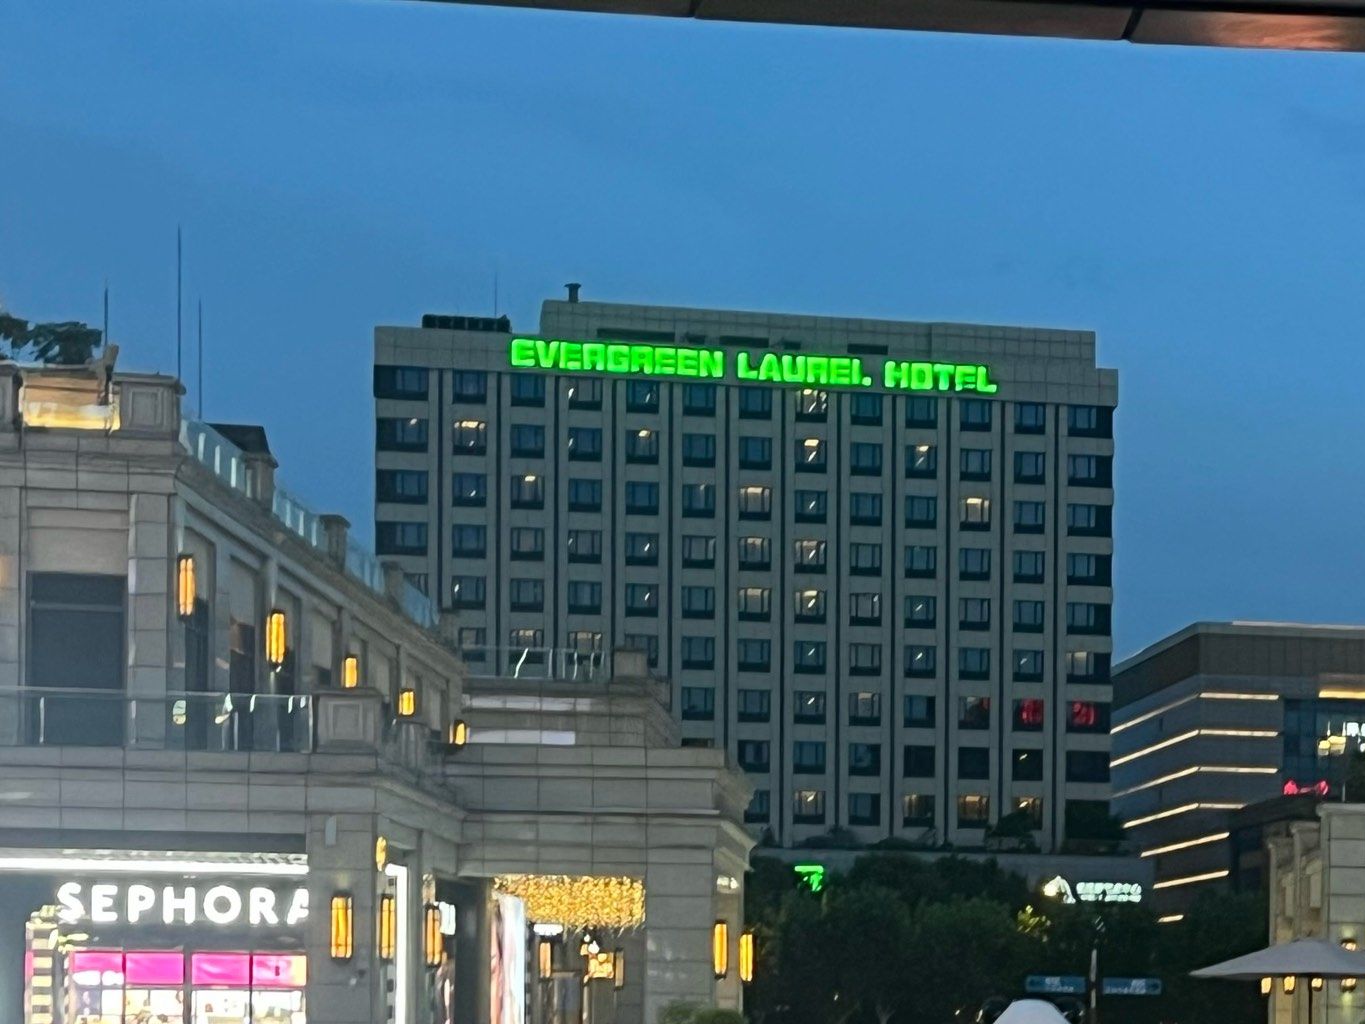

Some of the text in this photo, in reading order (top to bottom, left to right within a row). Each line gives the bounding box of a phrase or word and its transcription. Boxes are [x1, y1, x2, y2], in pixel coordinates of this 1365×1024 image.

[511, 339, 998, 393] EVERGREEN LAUREL HOTEL
[56, 882, 310, 925] SEPHORA
